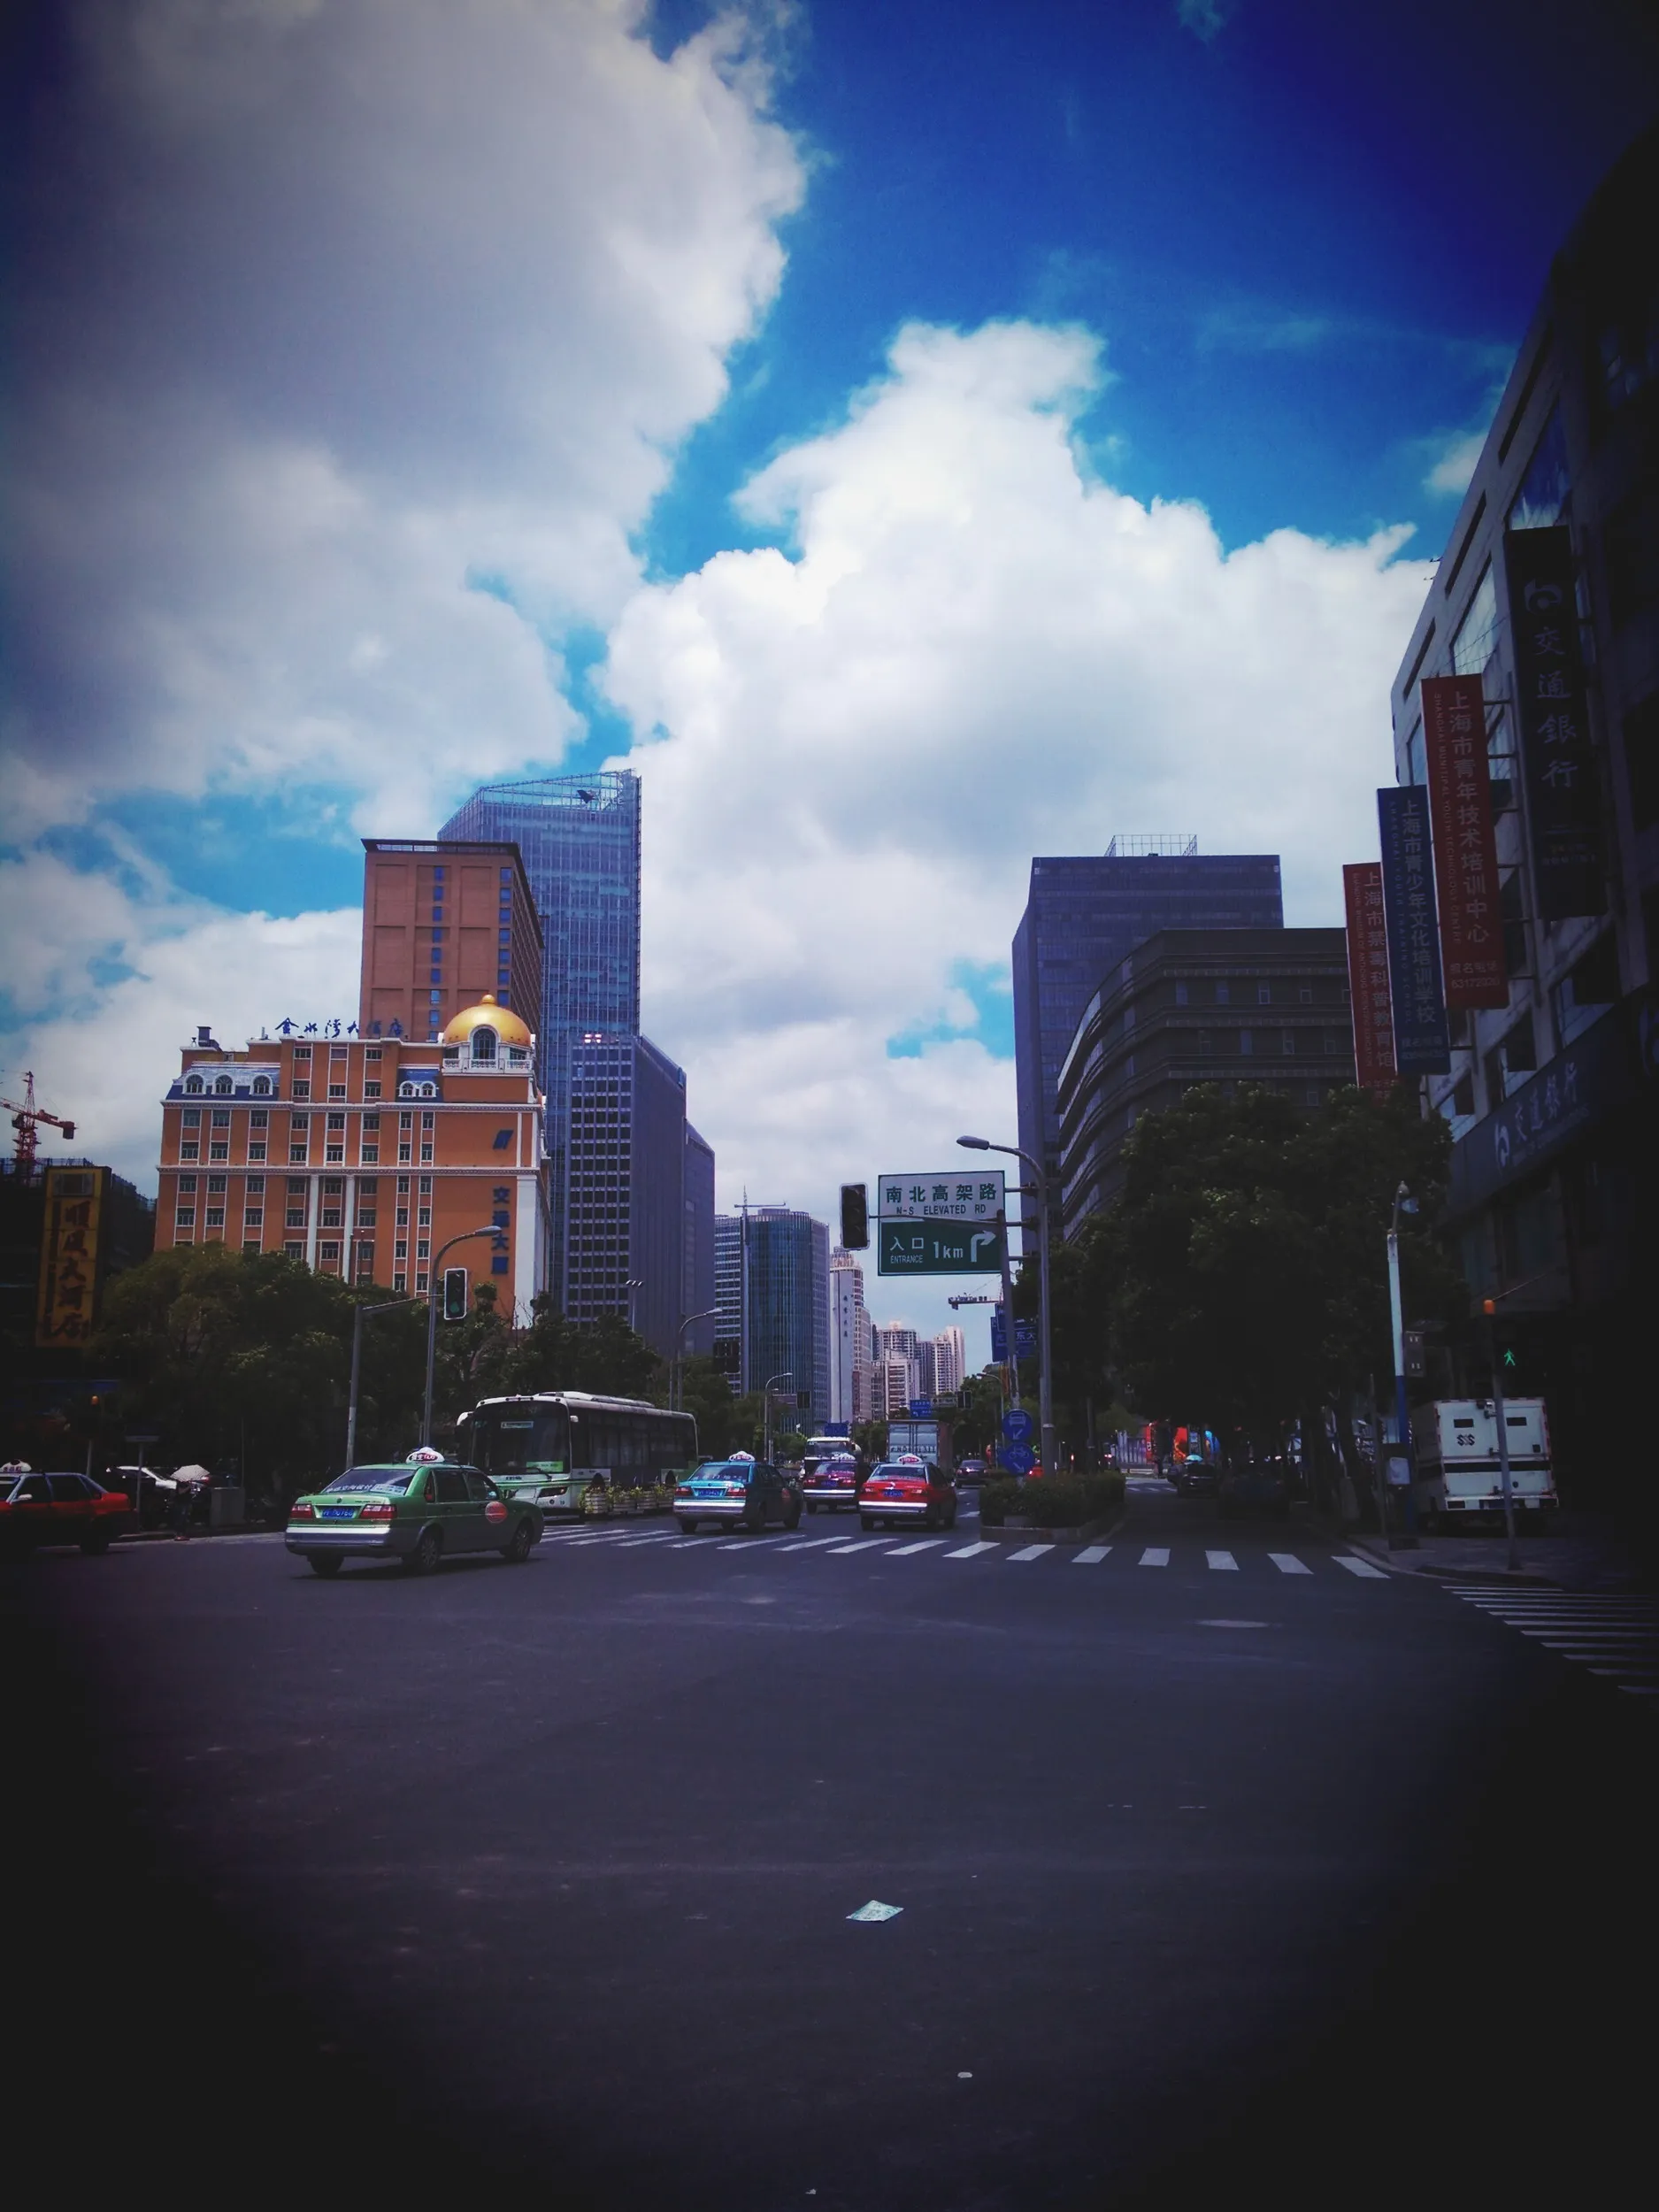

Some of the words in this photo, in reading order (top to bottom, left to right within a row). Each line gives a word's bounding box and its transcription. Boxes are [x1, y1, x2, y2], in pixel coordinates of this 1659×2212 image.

[1533, 626, 1578, 787] 交通銀行
[1441, 799, 1453, 832] YOUTH
[1448, 691, 1490, 943] 上海市青年技术培训中心
[1402, 800, 1436, 1024] 上海市青少年文化培训学校
[886, 1183, 997, 1203] 南北高架路
[896, 1207, 914, 1216] N-S
[924, 1204, 966, 1216] ELEVATED
[975, 1204, 986, 1213] RD
[890, 1236, 924, 1251] 入口
[933, 1240, 964, 1259] 1km
[890, 1255, 923, 1263] ENTRANCE
